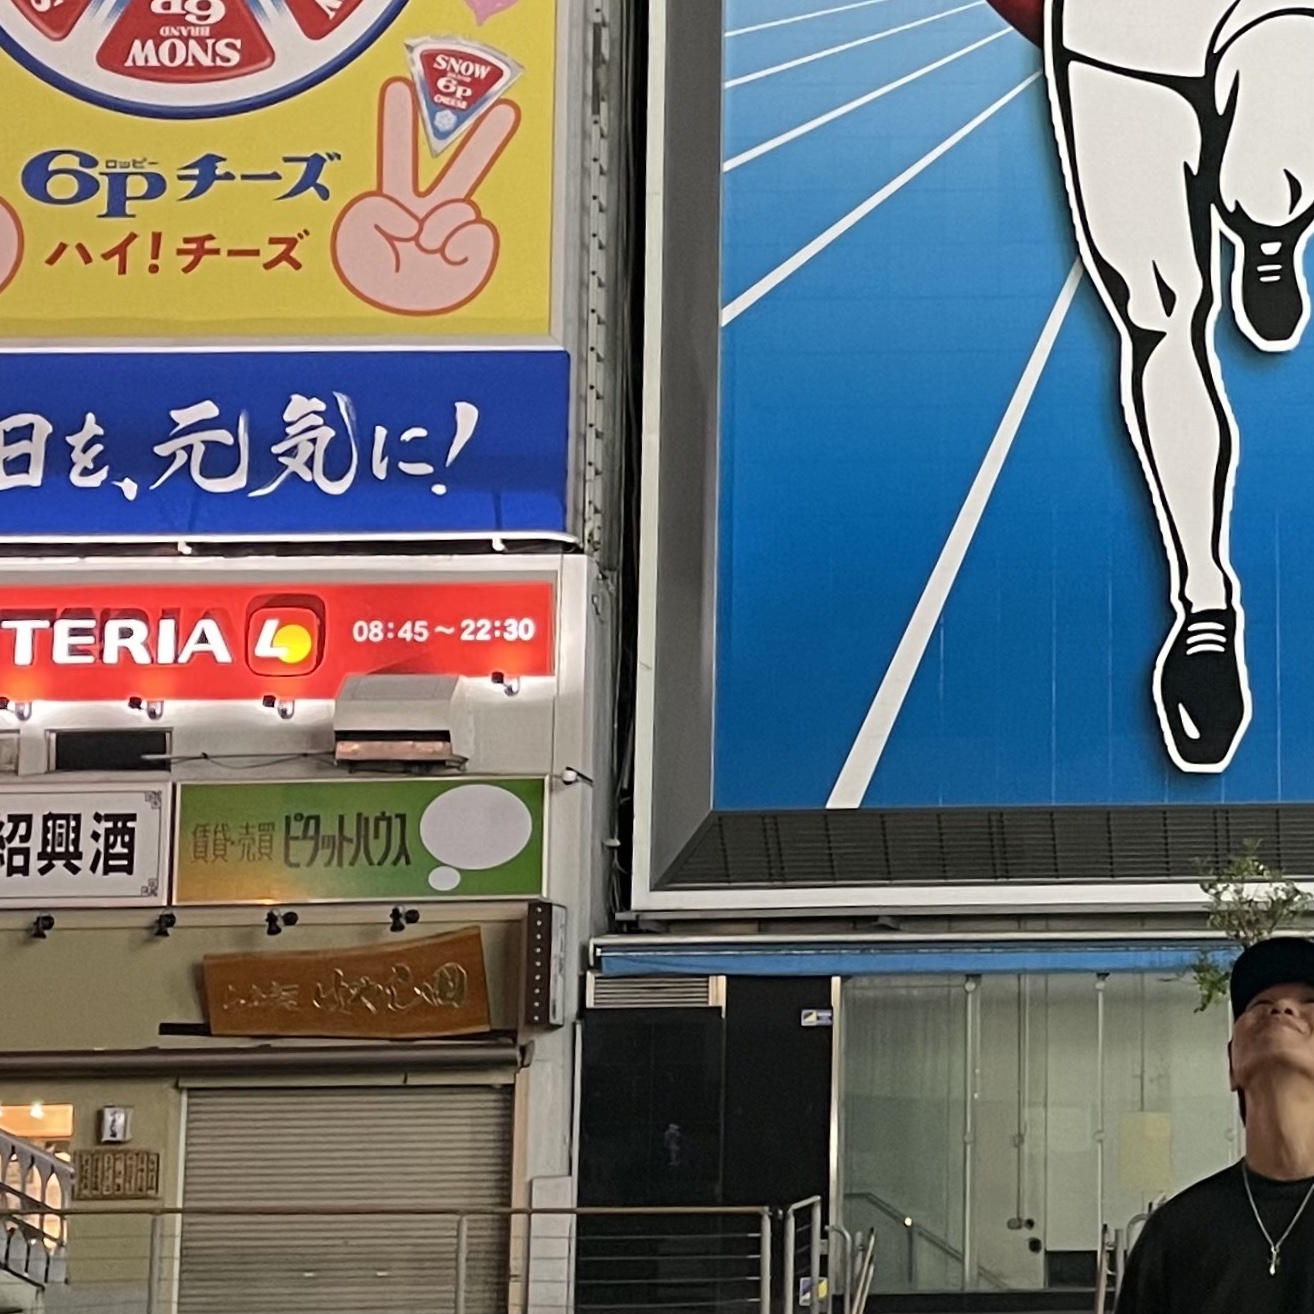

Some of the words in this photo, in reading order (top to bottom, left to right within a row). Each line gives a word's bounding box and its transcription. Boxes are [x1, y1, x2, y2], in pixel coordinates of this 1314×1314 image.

[160, 26, 210, 36] BRAND
[124, 38, 242, 67] SNOW
[433, 54, 490, 79] SNOW
[1, 618, 233, 665] TERIA
[284, 811, 411, 868] ピタットハウス
